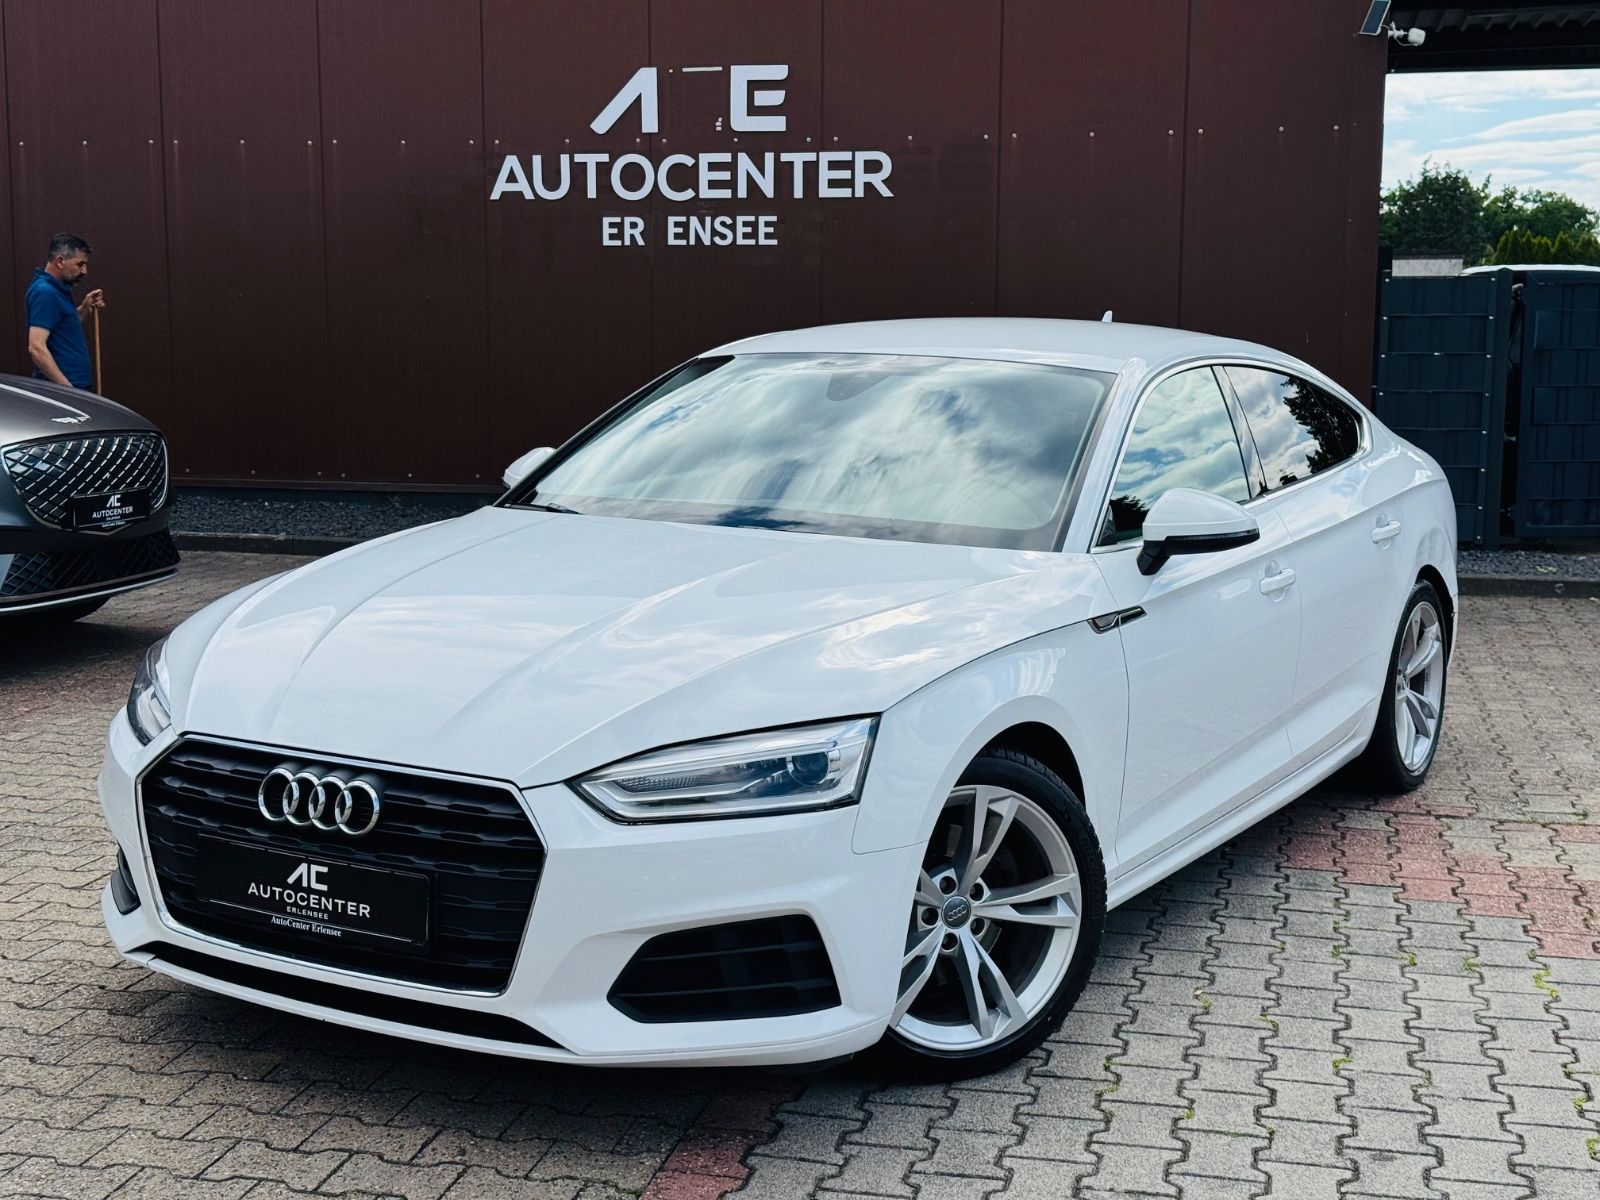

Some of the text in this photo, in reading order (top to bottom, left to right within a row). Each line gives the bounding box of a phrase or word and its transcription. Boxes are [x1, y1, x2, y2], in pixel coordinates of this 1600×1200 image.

[489, 150, 895, 202] AUTOCENTER
[92, 506, 133, 518] AUTOCENTER
[286, 862, 329, 892] AC
[247, 882, 371, 919] AUTOCENTER
[286, 905, 329, 920] ERLENSEE
[270, 915, 342, 937] AutoCenter Erlensee
